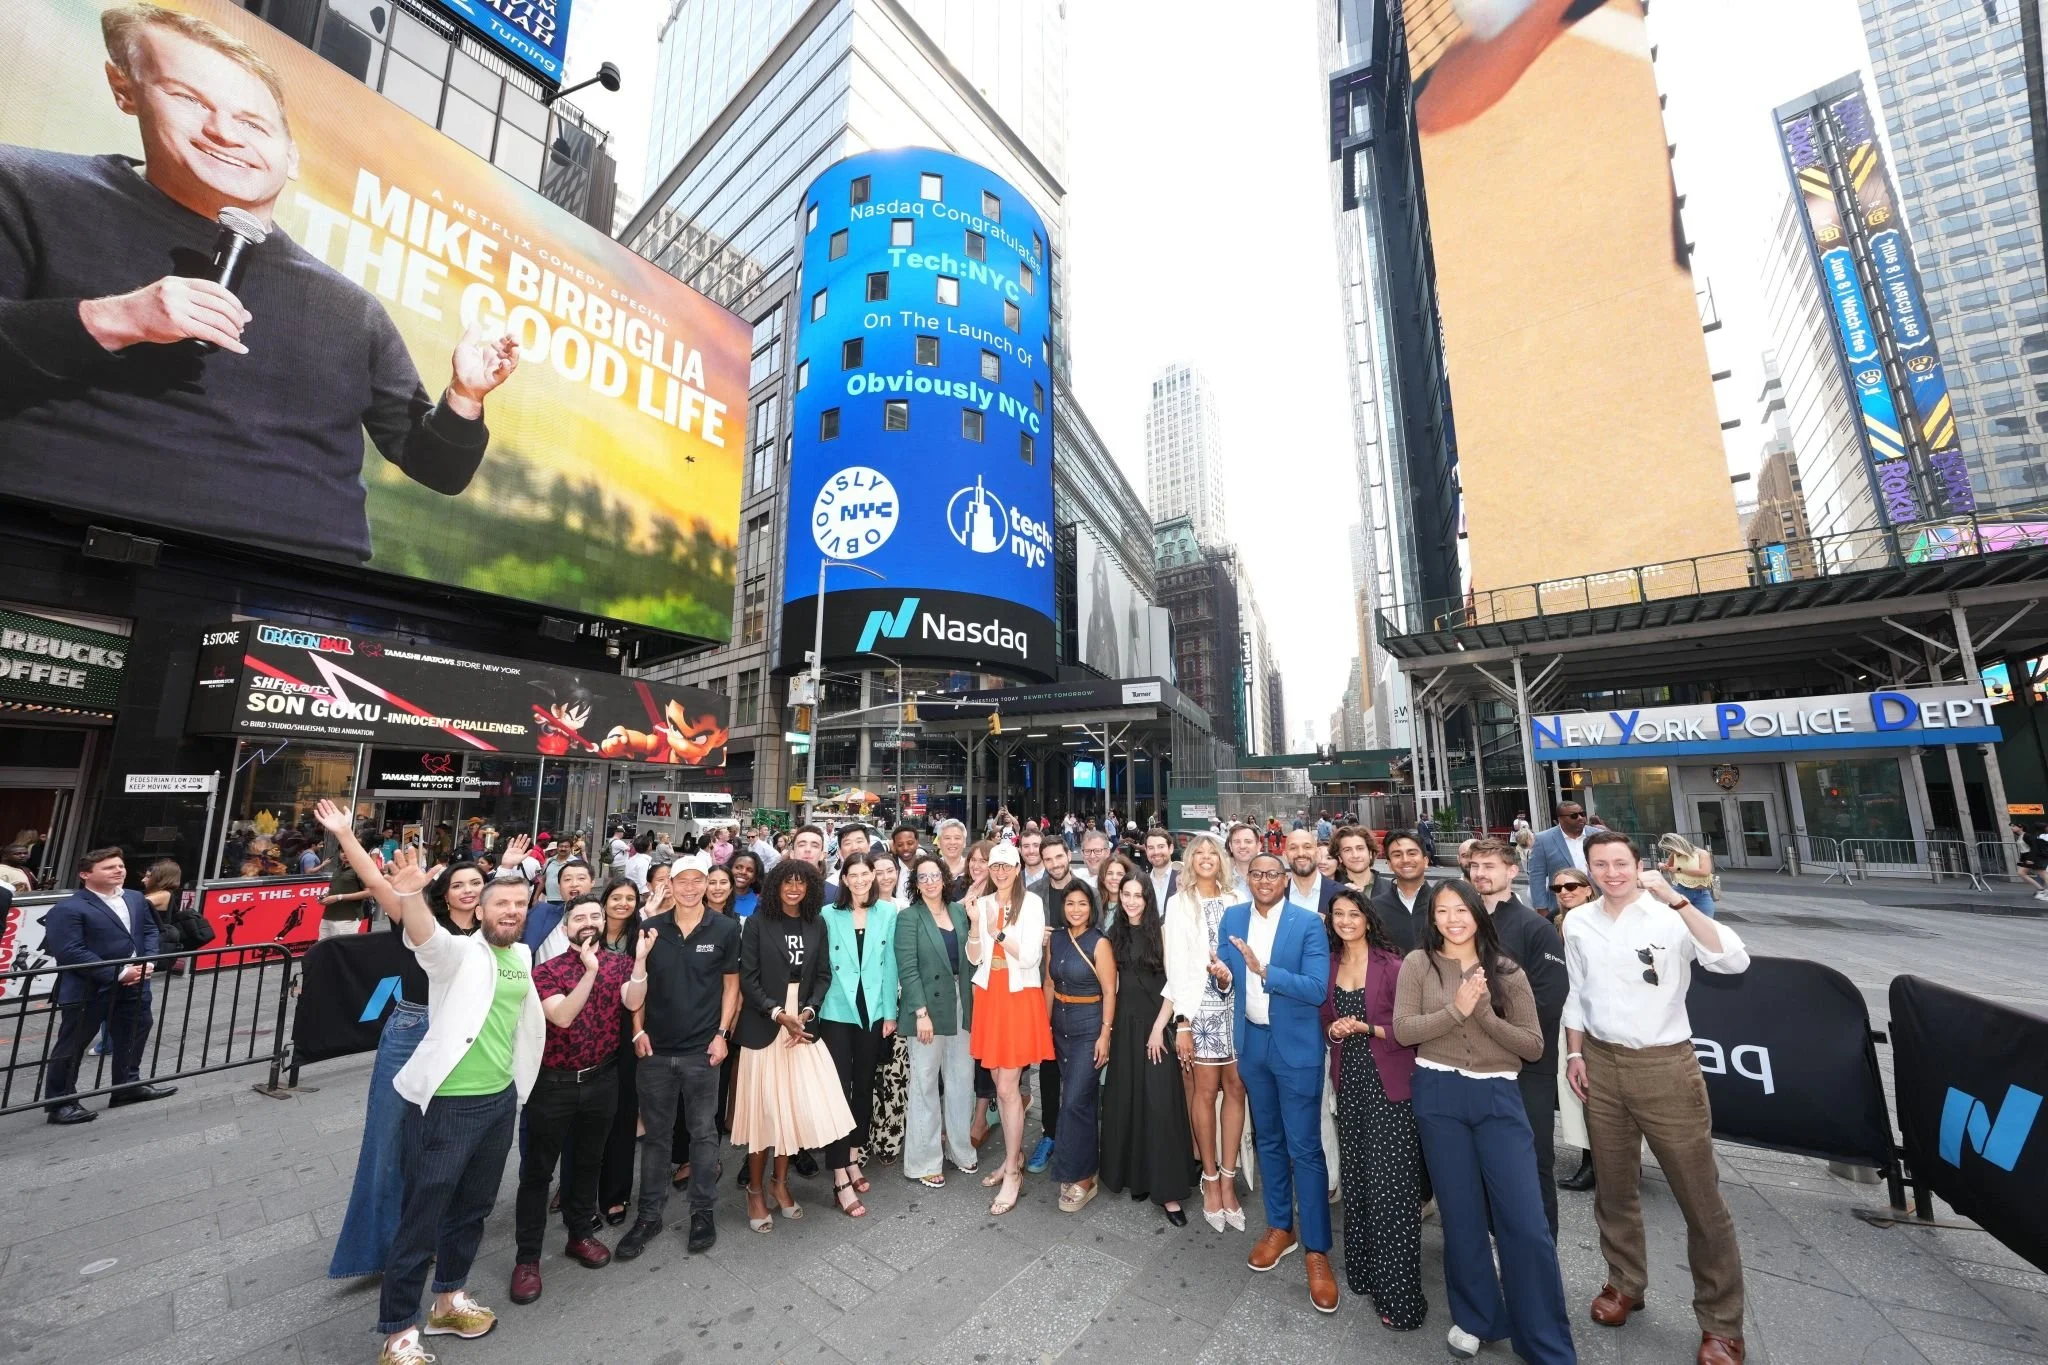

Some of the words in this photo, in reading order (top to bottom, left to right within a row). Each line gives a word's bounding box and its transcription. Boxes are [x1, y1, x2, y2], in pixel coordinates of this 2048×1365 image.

[490, 18, 556, 72] Turning
[431, 190, 444, 201] A
[453, 202, 532, 251] NETFLIX
[538, 249, 606, 289] COMEDY
[610, 288, 669, 328] SPECIAL
[850, 199, 924, 222] Nasdaq
[932, 202, 1042, 276] Congratulates
[352, 168, 499, 283] MIKE
[506, 251, 706, 390] BIRBIGLIA
[887, 248, 1020, 301] Tech:NYC
[293, 193, 449, 322] THE
[459, 282, 628, 400] GOOD
[637, 367, 728, 447] LIFE
[1829, 256, 1847, 282] June
[1840, 294, 1860, 331] Watch
[1850, 329, 1867, 353] free
[863, 312, 891, 330] On
[899, 311, 940, 330] The
[947, 317, 1013, 356] Launch
[1016, 347, 1034, 369] Of
[846, 369, 994, 410] Obviously
[998, 392, 1041, 434] NYC
[815, 470, 884, 554] OBVIOUSLY
[840, 501, 893, 521] NYC
[1011, 536, 1046, 569] nyc
[1, 627, 127, 670] RBUCKS
[921, 612, 1028, 659] Nasdaq
[456, 659, 481, 670] STORE
[482, 664, 500, 672] NEW
[500, 666, 521, 676] YORK
[246, 692, 305, 715] SON
[310, 699, 381, 722] GOKU
[382, 711, 452, 729] -INNOCENT
[452, 718, 528, 736] CHALLENGER-
[249, 720, 267, 729] BIRD
[327, 726, 341, 734] TOEI
[341, 727, 375, 737] ANIMATION
[1530, 715, 1606, 750] NEW
[1608, 710, 1708, 746] YORK
[1716, 703, 1856, 740] POLICE
[1867, 691, 1997, 732] DEPT
[455, 776, 480, 784] STORE
[640, 795, 672, 817] FedEx
[218, 892, 254, 904] OFF.
[259, 889, 295, 900] THE.
[0, 906, 21, 998] ICAGO
